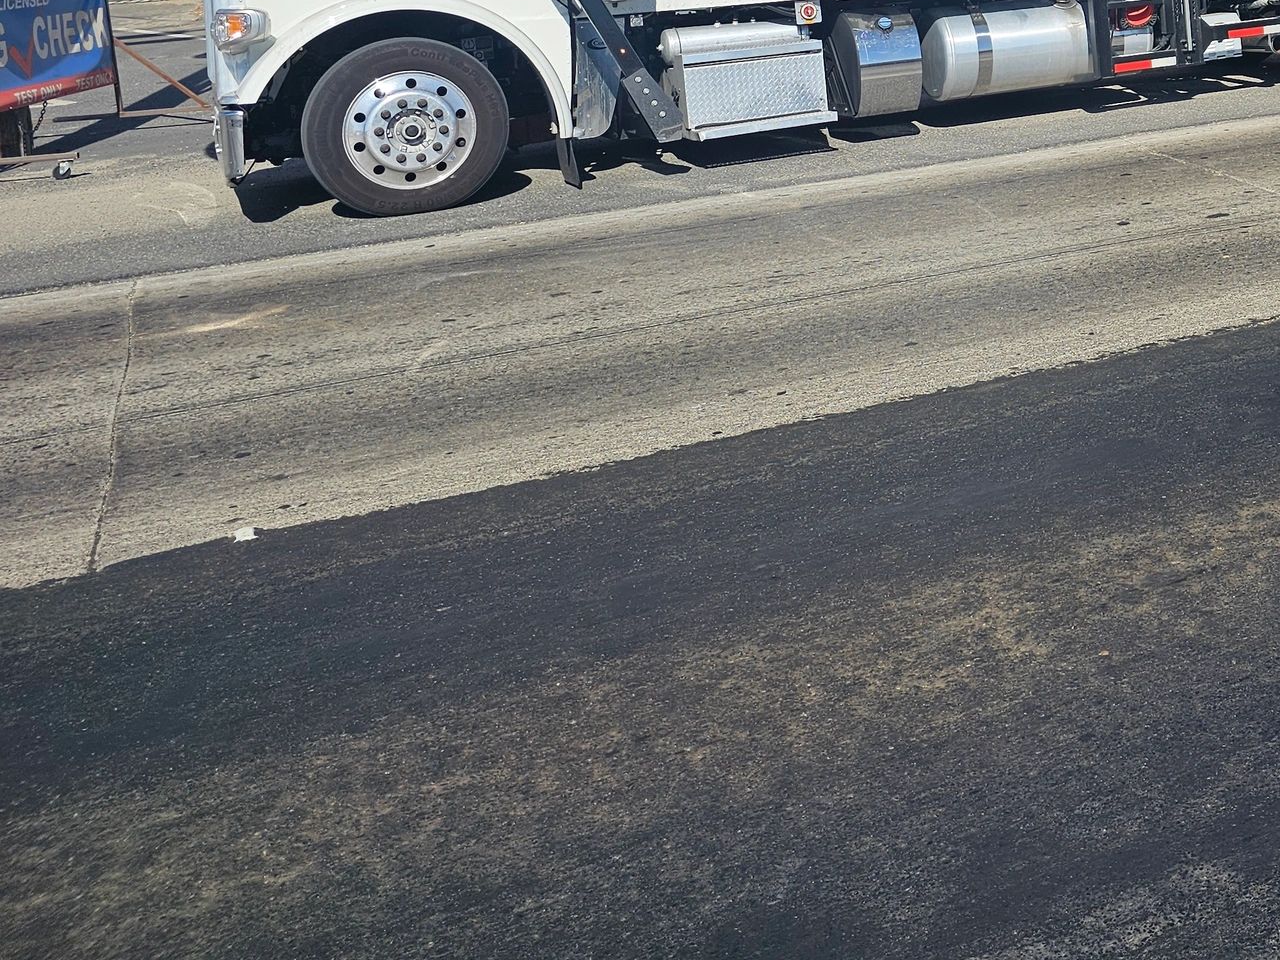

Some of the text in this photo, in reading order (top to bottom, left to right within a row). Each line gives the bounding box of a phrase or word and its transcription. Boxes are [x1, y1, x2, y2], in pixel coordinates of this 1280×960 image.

[33, 7, 109, 59] CHECK
[76, 75, 94, 89] TEST
[14, 83, 62, 105] TEST ONLY
